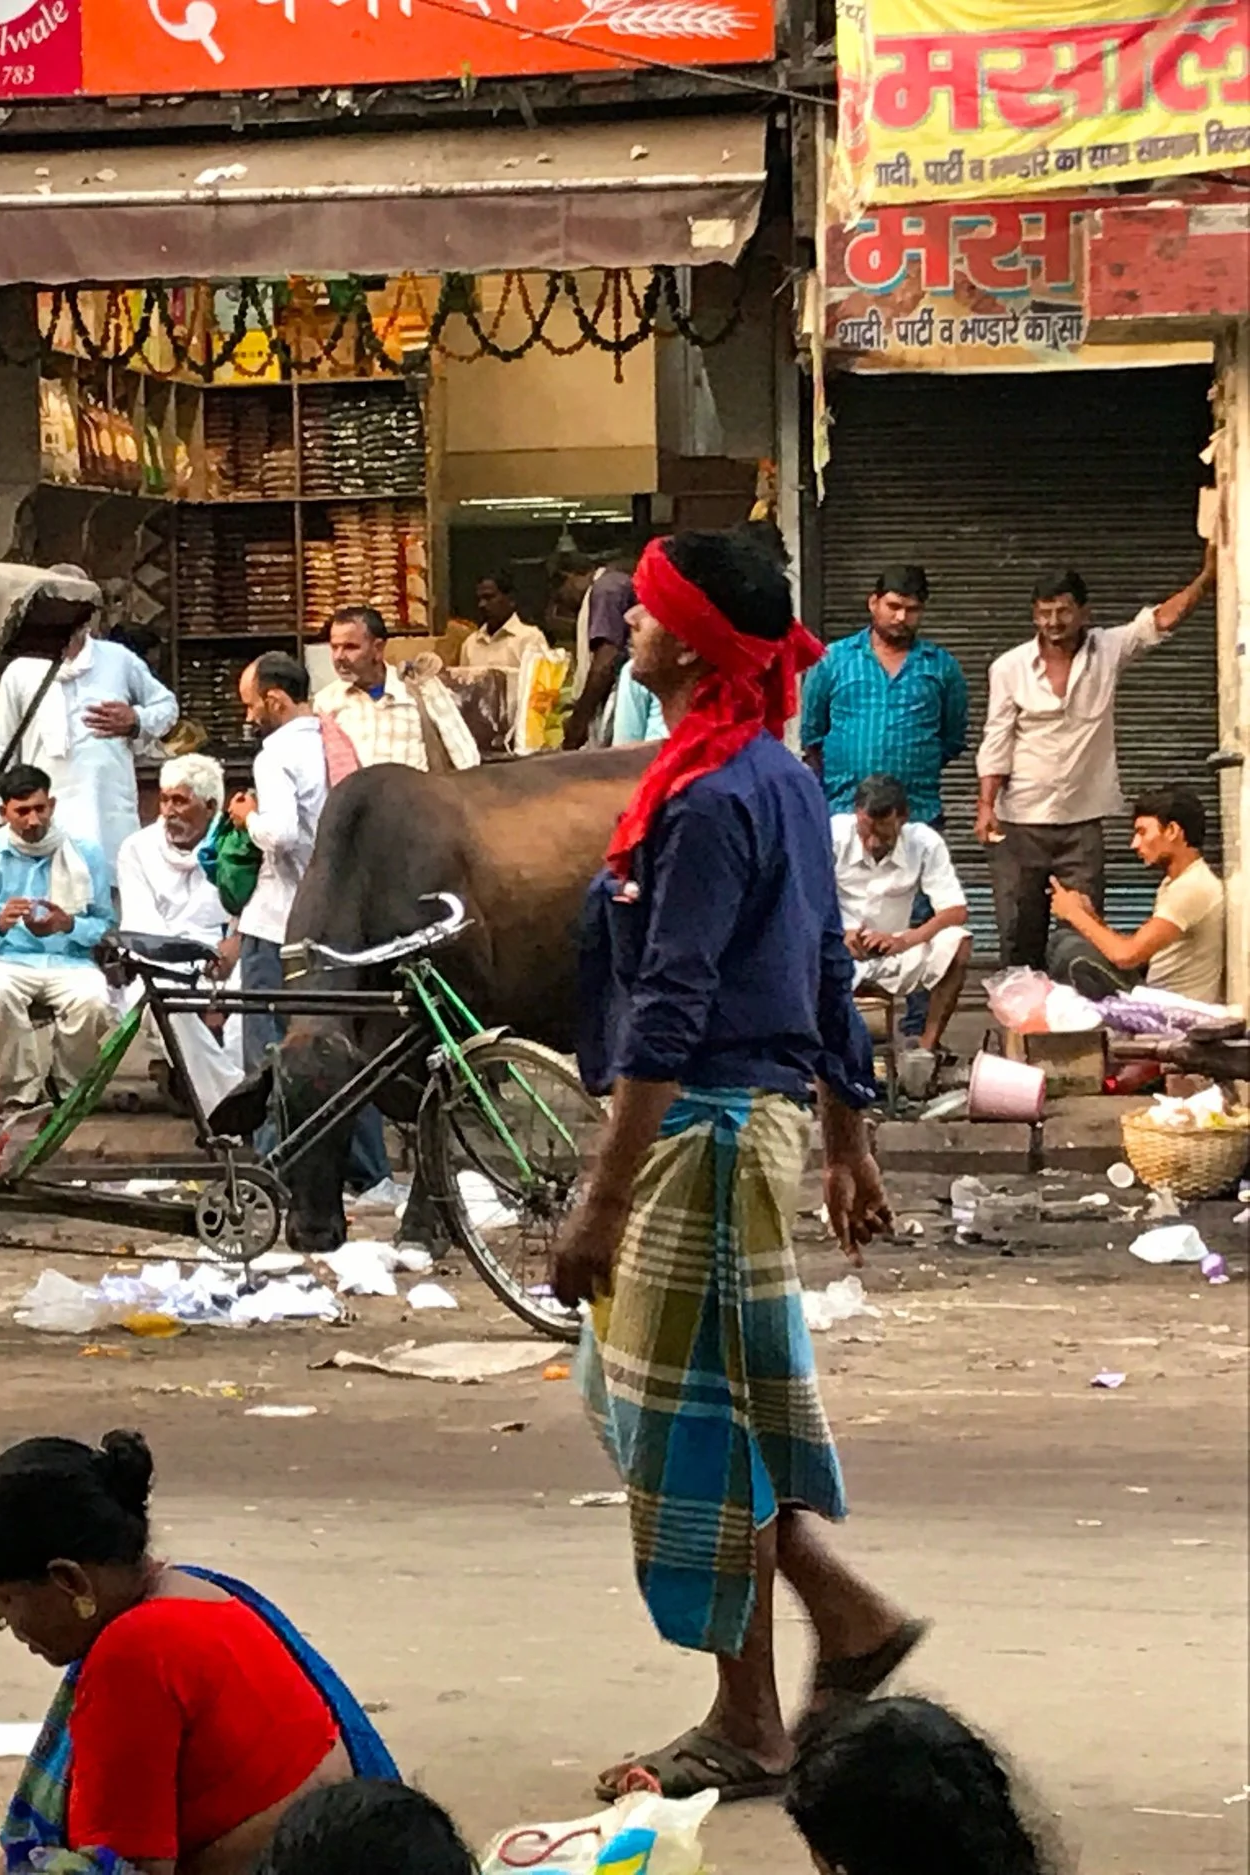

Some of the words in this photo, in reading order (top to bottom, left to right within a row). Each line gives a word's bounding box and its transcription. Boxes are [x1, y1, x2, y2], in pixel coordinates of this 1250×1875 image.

[895, 307, 934, 347] पार्टी
[939, 317, 954, 345] व
[959, 312, 1021, 347] भण्डारे
